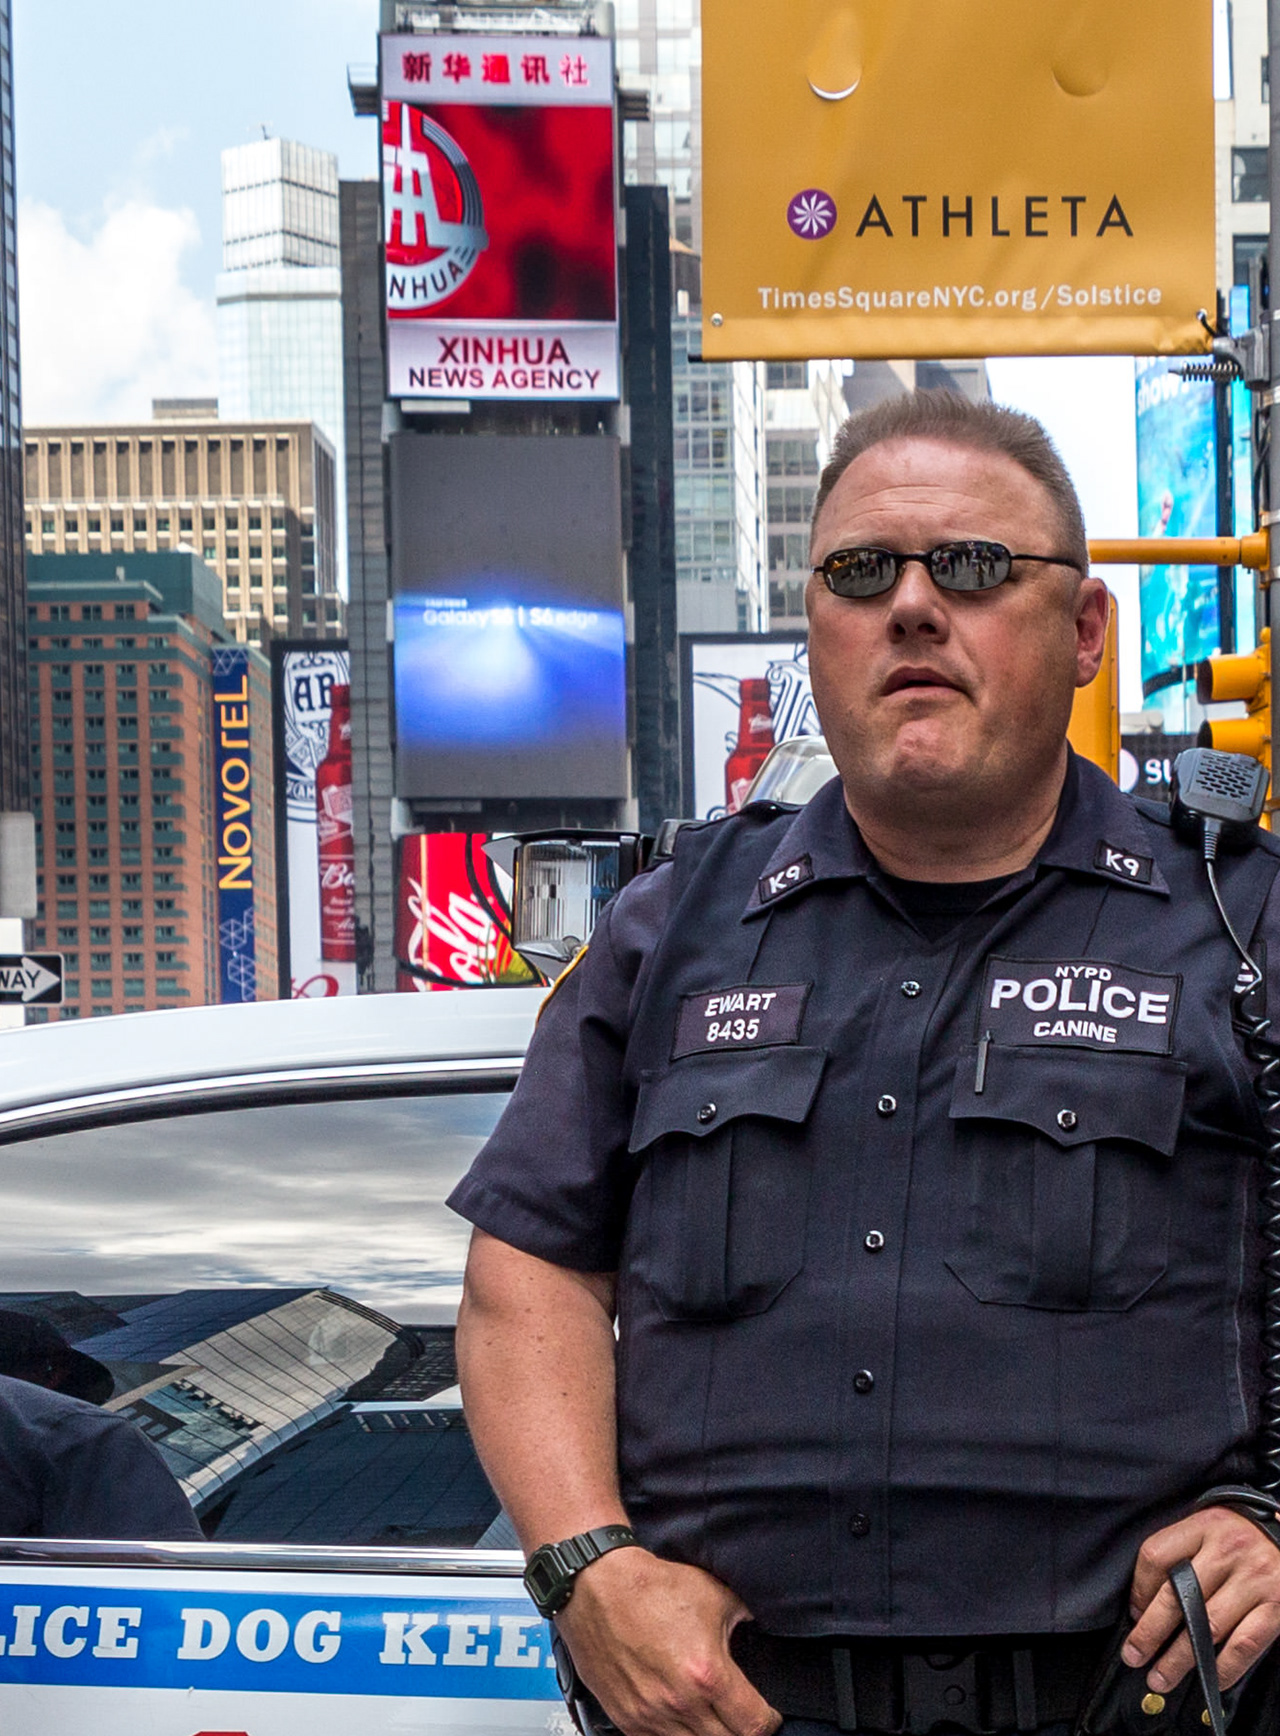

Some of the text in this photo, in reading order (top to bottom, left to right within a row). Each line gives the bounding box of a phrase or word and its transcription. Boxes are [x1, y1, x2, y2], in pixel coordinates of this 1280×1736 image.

[402, 51, 589, 87] 新华通讯社
[856, 194, 1134, 238] ATHLETA
[758, 283, 1162, 312] TimesSquareNYC.org/Solstice
[438, 337, 570, 365] XINHUA
[408, 368, 601, 389] NEWS AGENCY
[423, 609, 490, 628] Galaxy
[529, 607, 555, 626] S6
[556, 612, 599, 630] edge
[214, 675, 253, 890] NOVOTEL
[1105, 850, 1140, 878] K9
[769, 864, 801, 894] K9
[1055, 965, 1112, 984] NYPD
[704, 992, 776, 1018] EWART
[990, 979, 1170, 1024] POLICE
[706, 1018, 760, 1043] 8435
[1032, 1020, 1117, 1045] CANINE
[178, 1607, 342, 1663] DOG
